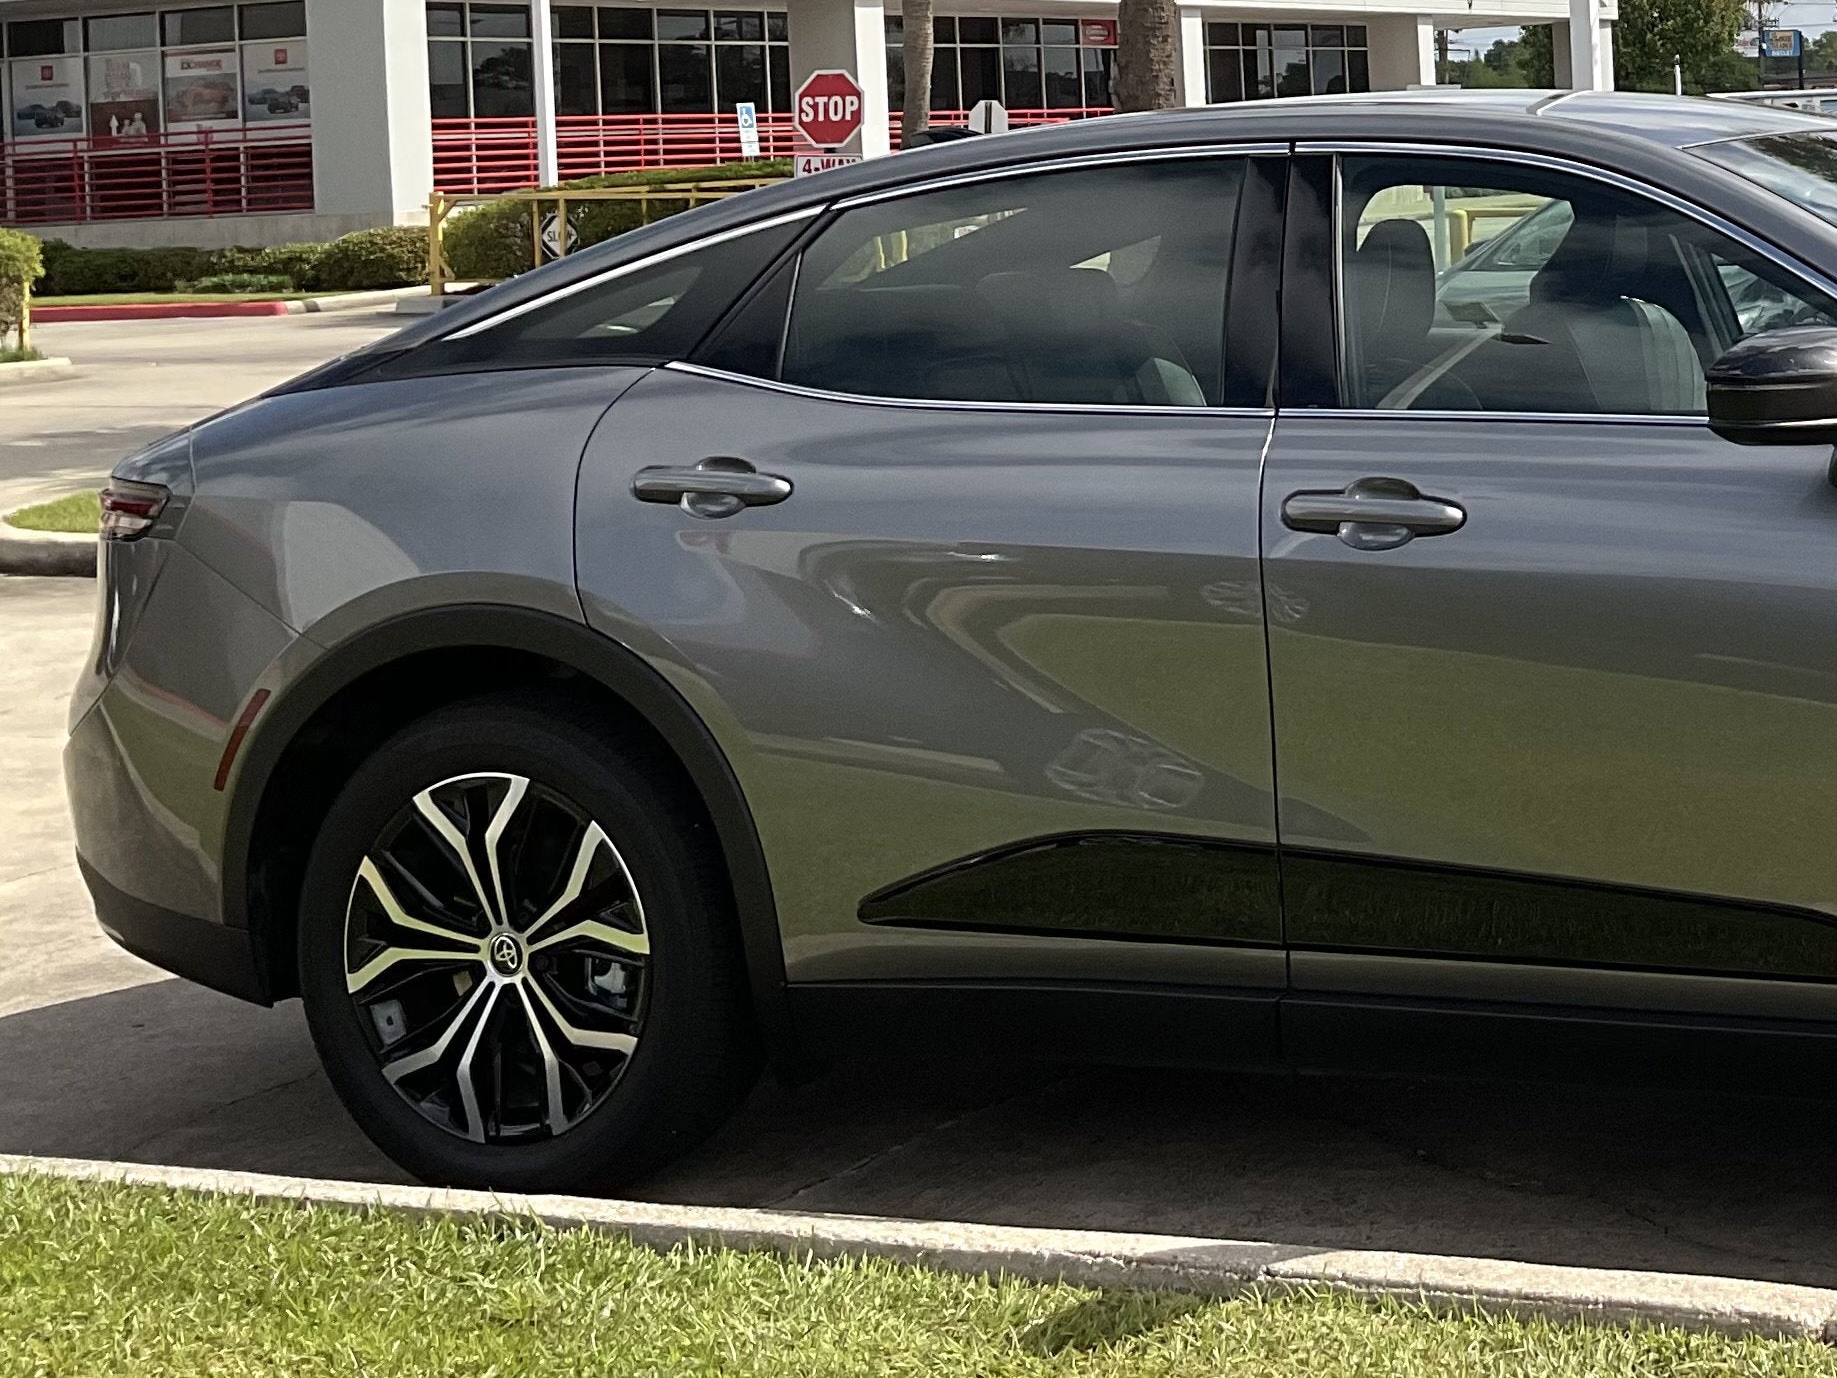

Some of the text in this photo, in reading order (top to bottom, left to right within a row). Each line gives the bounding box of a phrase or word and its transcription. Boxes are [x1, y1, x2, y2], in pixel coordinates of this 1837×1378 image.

[800, 95, 860, 123] STOP
[802, 158, 857, 174] 4-W
[547, 230, 575, 243] SLW
